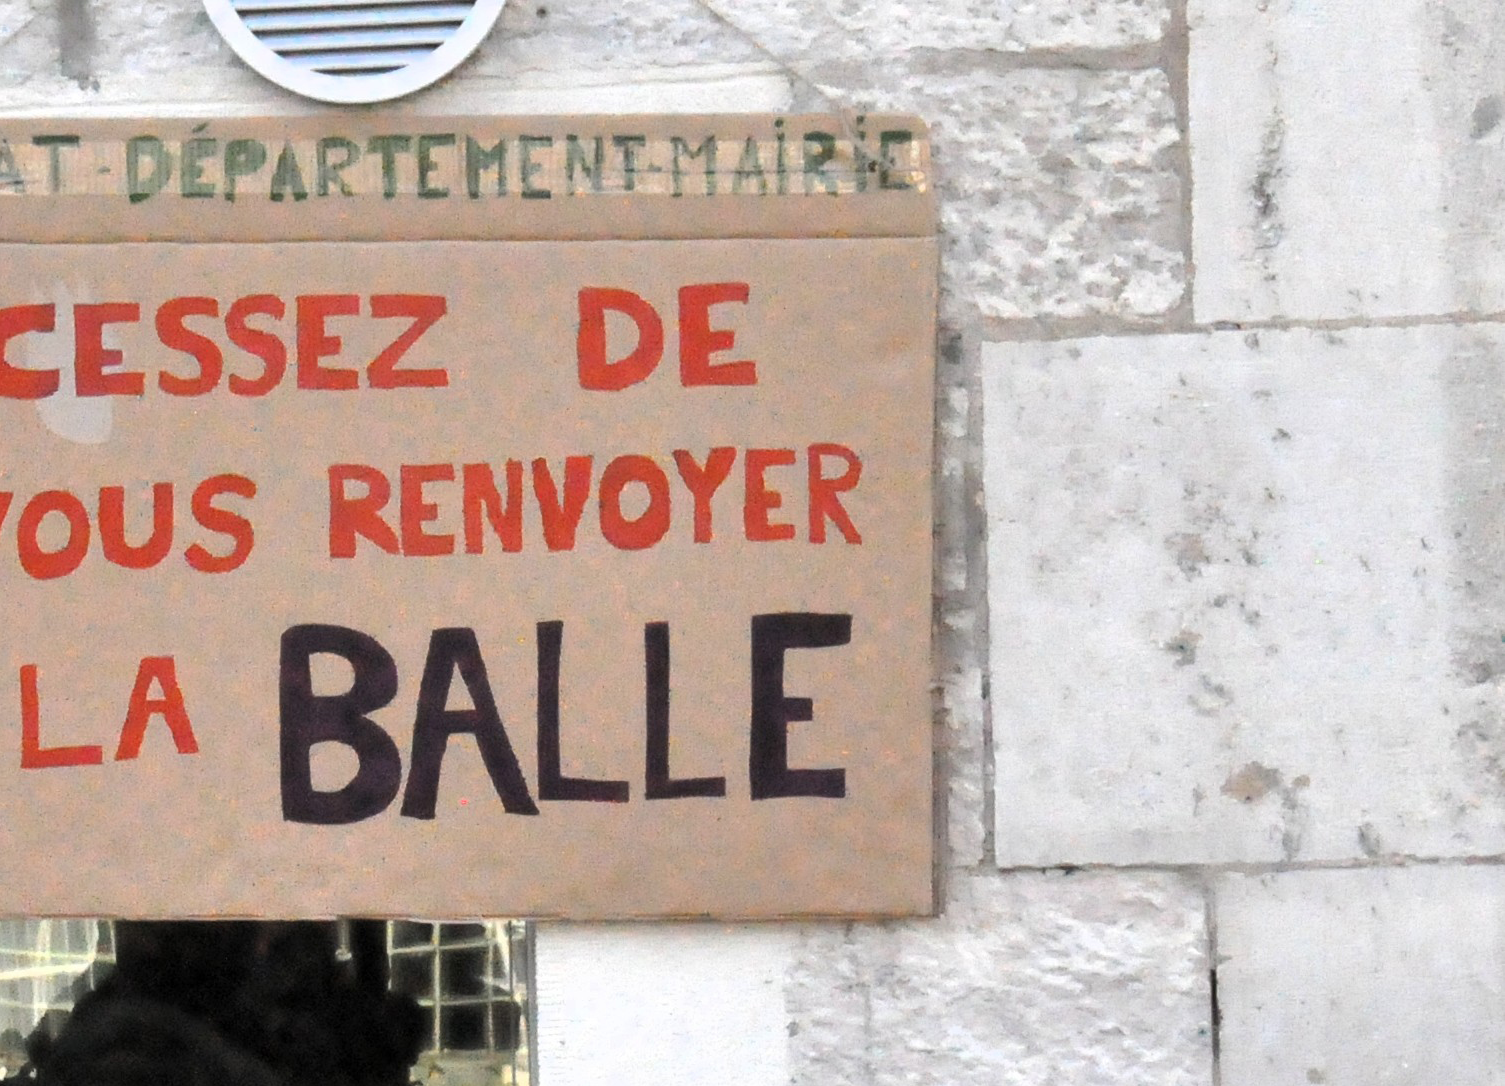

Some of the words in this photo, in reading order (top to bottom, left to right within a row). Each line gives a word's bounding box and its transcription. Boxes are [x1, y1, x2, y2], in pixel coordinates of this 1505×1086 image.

[577, 282, 758, 391] DE
[328, 443, 863, 559] RENVOYER
[19, 656, 200, 769] LA
[279, 612, 854, 825] BALLE
